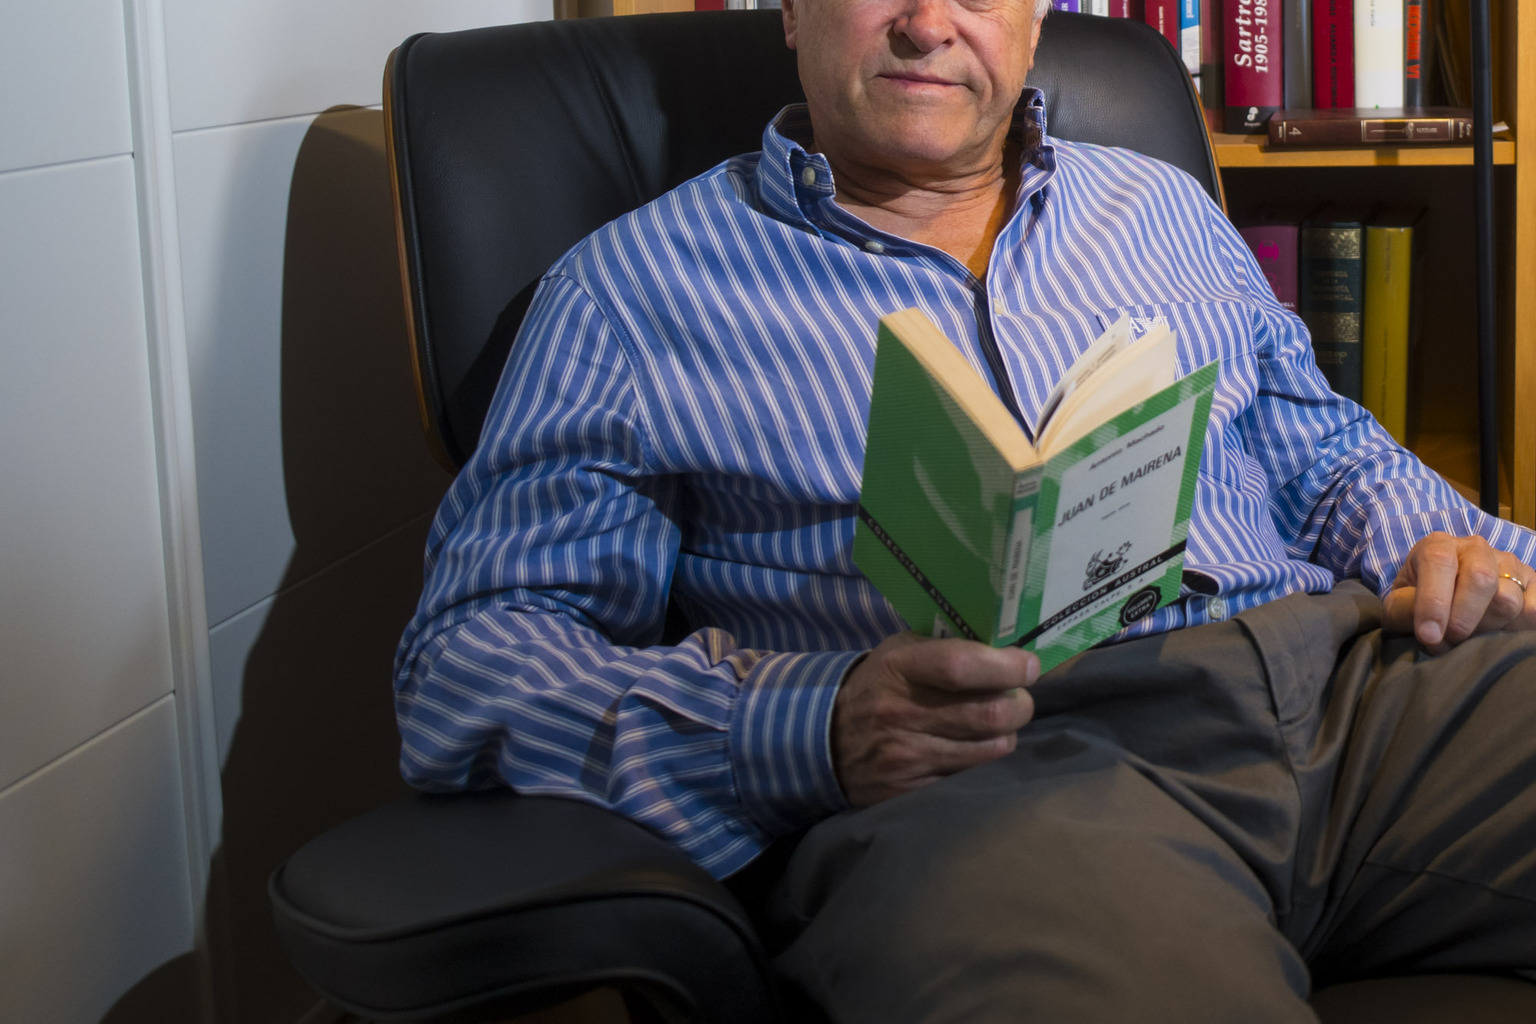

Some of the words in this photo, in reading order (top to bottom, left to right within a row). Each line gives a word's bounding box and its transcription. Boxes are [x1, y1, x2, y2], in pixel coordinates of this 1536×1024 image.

[1089, 448, 1123, 471] Antonio
[1127, 425, 1165, 448] Machado
[1058, 495, 1095, 527] JUAN
[1099, 480, 1117, 501] DE
[1121, 446, 1182, 488] MAIRENA
[1114, 556, 1163, 587] AUSTRAL
